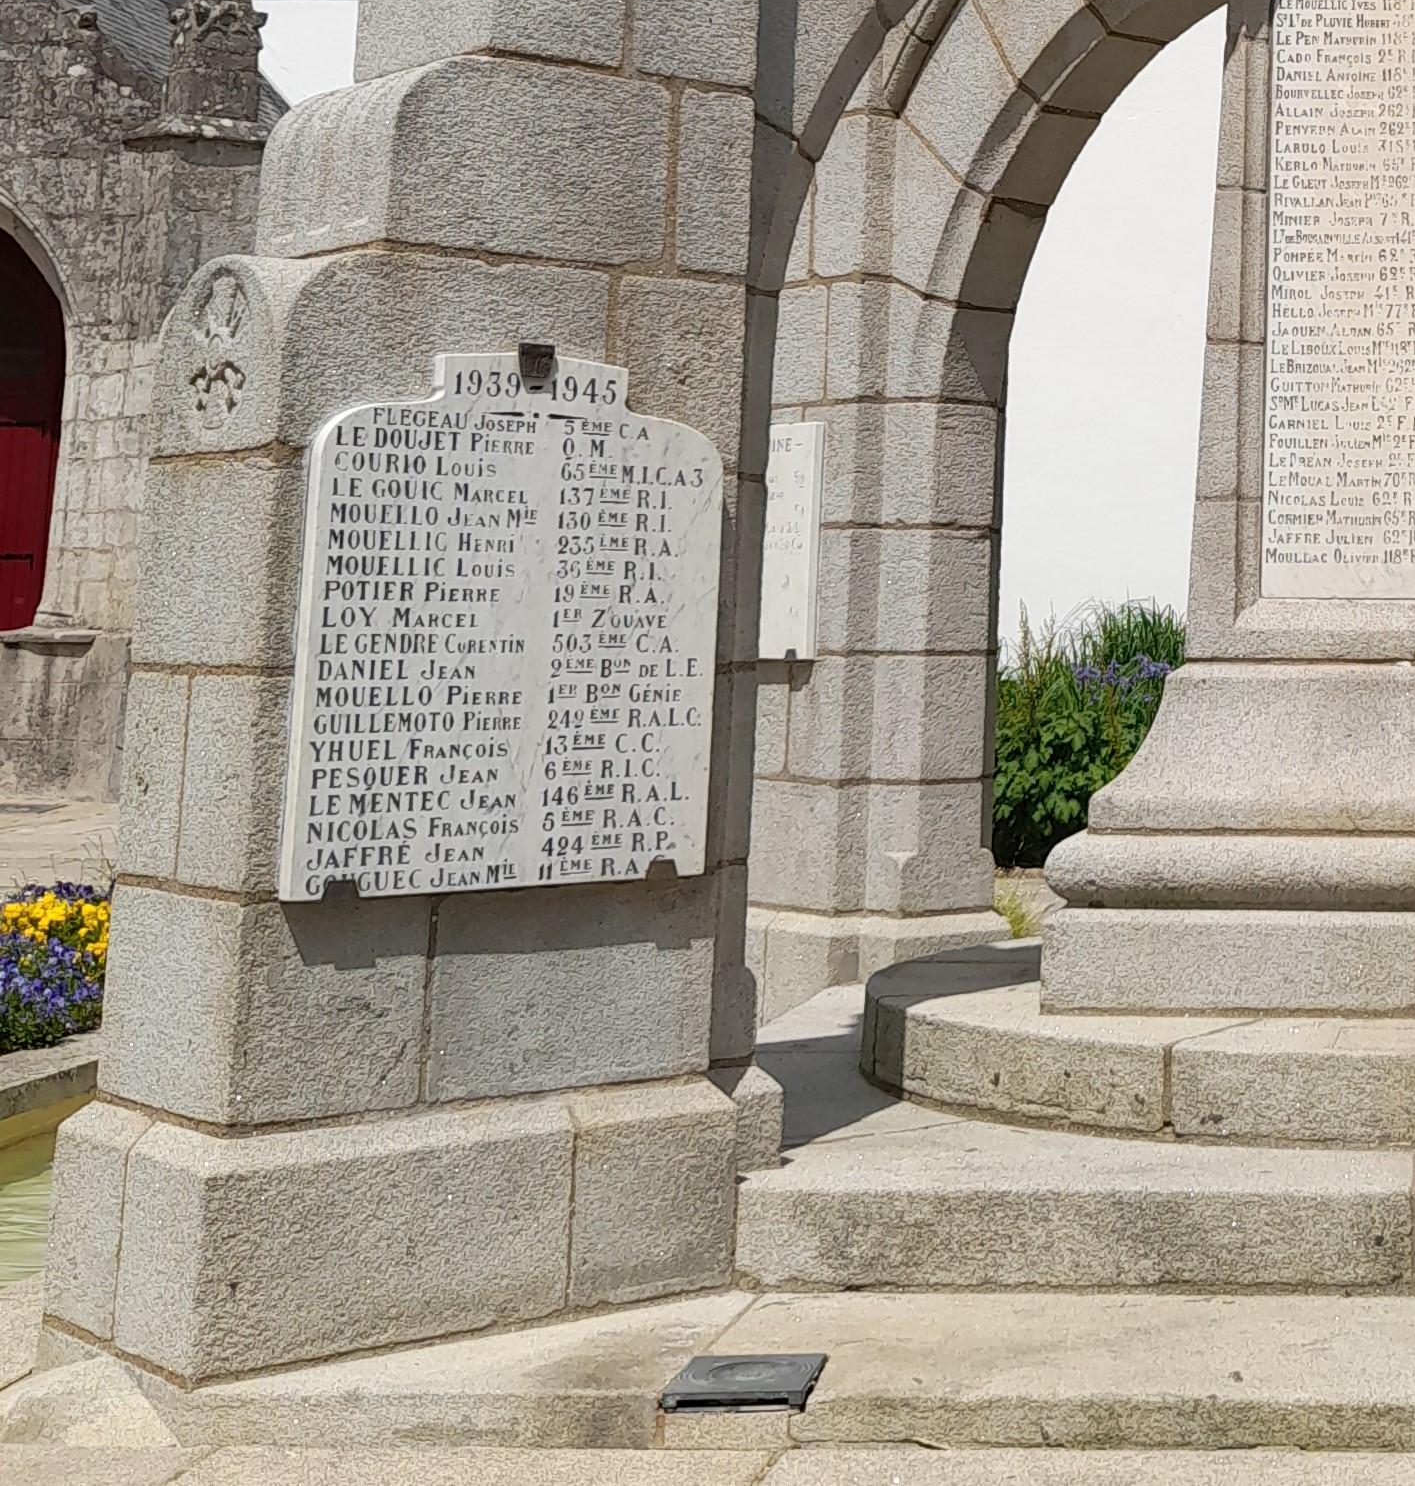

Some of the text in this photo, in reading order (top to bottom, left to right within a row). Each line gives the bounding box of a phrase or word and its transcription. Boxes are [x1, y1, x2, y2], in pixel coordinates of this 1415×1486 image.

[336, 426, 365, 446] LE
[374, 428, 460, 451] DOUJET
[335, 452, 426, 474] COURIO
[333, 478, 362, 497] LE
[331, 503, 438, 525] MOUELLO
[328, 529, 446, 551] MOUELLIC
[327, 555, 445, 576] MOUELLIC
[324, 581, 413, 601] POTIER
[322, 607, 377, 627] LOY
[319, 634, 347, 654] LE
[355, 634, 438, 654] GENDRE
[318, 660, 408, 681] DANIEL
[639, 664, 658, 677] DE
[316, 686, 432, 707] MOUELLO
[314, 712, 454, 734] GUILLEMOTO
[310, 740, 396, 762] YHUEL
[312, 766, 427, 791] PESQUER
[310, 795, 341, 816] LE
[349, 791, 449, 817] MENTEC
[307, 818, 417, 844] NICOLAS
[307, 841, 410, 870] JAFFRÉ
